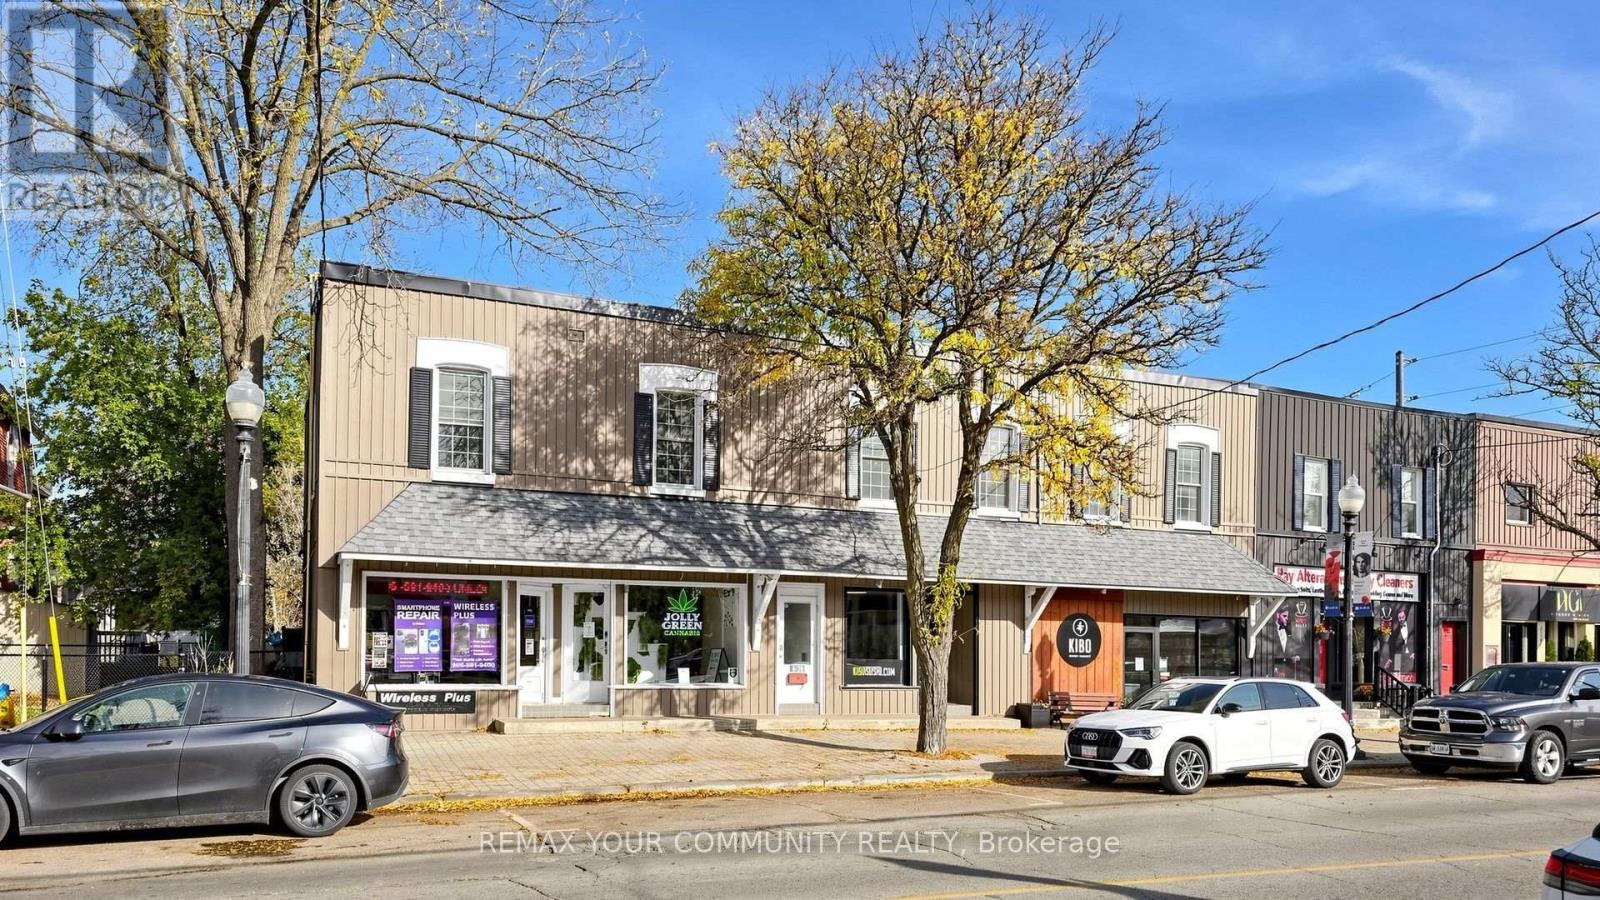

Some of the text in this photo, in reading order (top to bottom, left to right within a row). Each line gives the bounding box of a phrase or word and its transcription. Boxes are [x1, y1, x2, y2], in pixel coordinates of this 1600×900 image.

[1377, 573, 1414, 589] Cleaners
[454, 603, 495, 611] WIRELESS
[397, 611, 440, 620] REPAIR
[454, 612, 475, 620] PLUS
[664, 613, 700, 621] JOLLY
[662, 621, 702, 630] GREEN
[1068, 638, 1092, 653] KIBO
[380, 692, 471, 703] Wireless Plus
